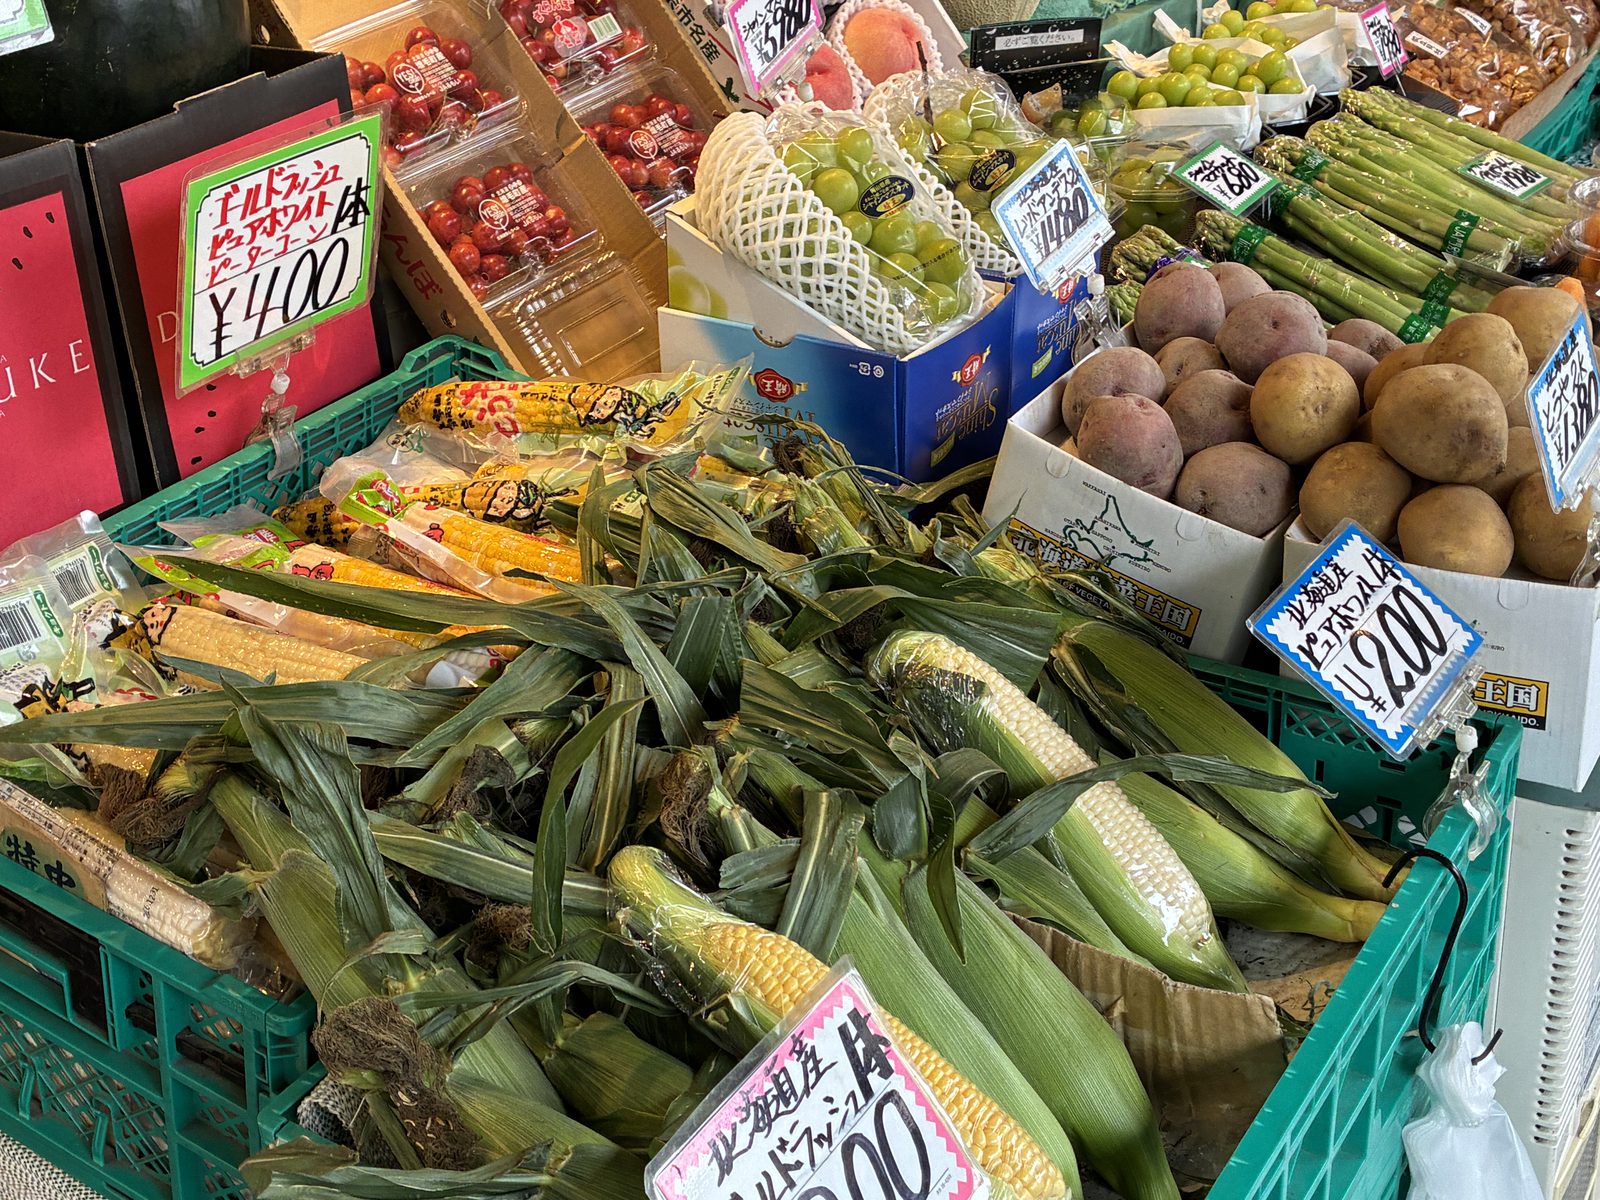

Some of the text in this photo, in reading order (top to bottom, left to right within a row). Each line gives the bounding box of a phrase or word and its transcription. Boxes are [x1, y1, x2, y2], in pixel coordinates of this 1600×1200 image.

[666, 0, 721, 65] 市名産
[396, 68, 415, 82] YES!
[212, 159, 344, 230] ゴールドラッシュ
[481, 204, 500, 219] YES!
[209, 237, 349, 359] ¥400
